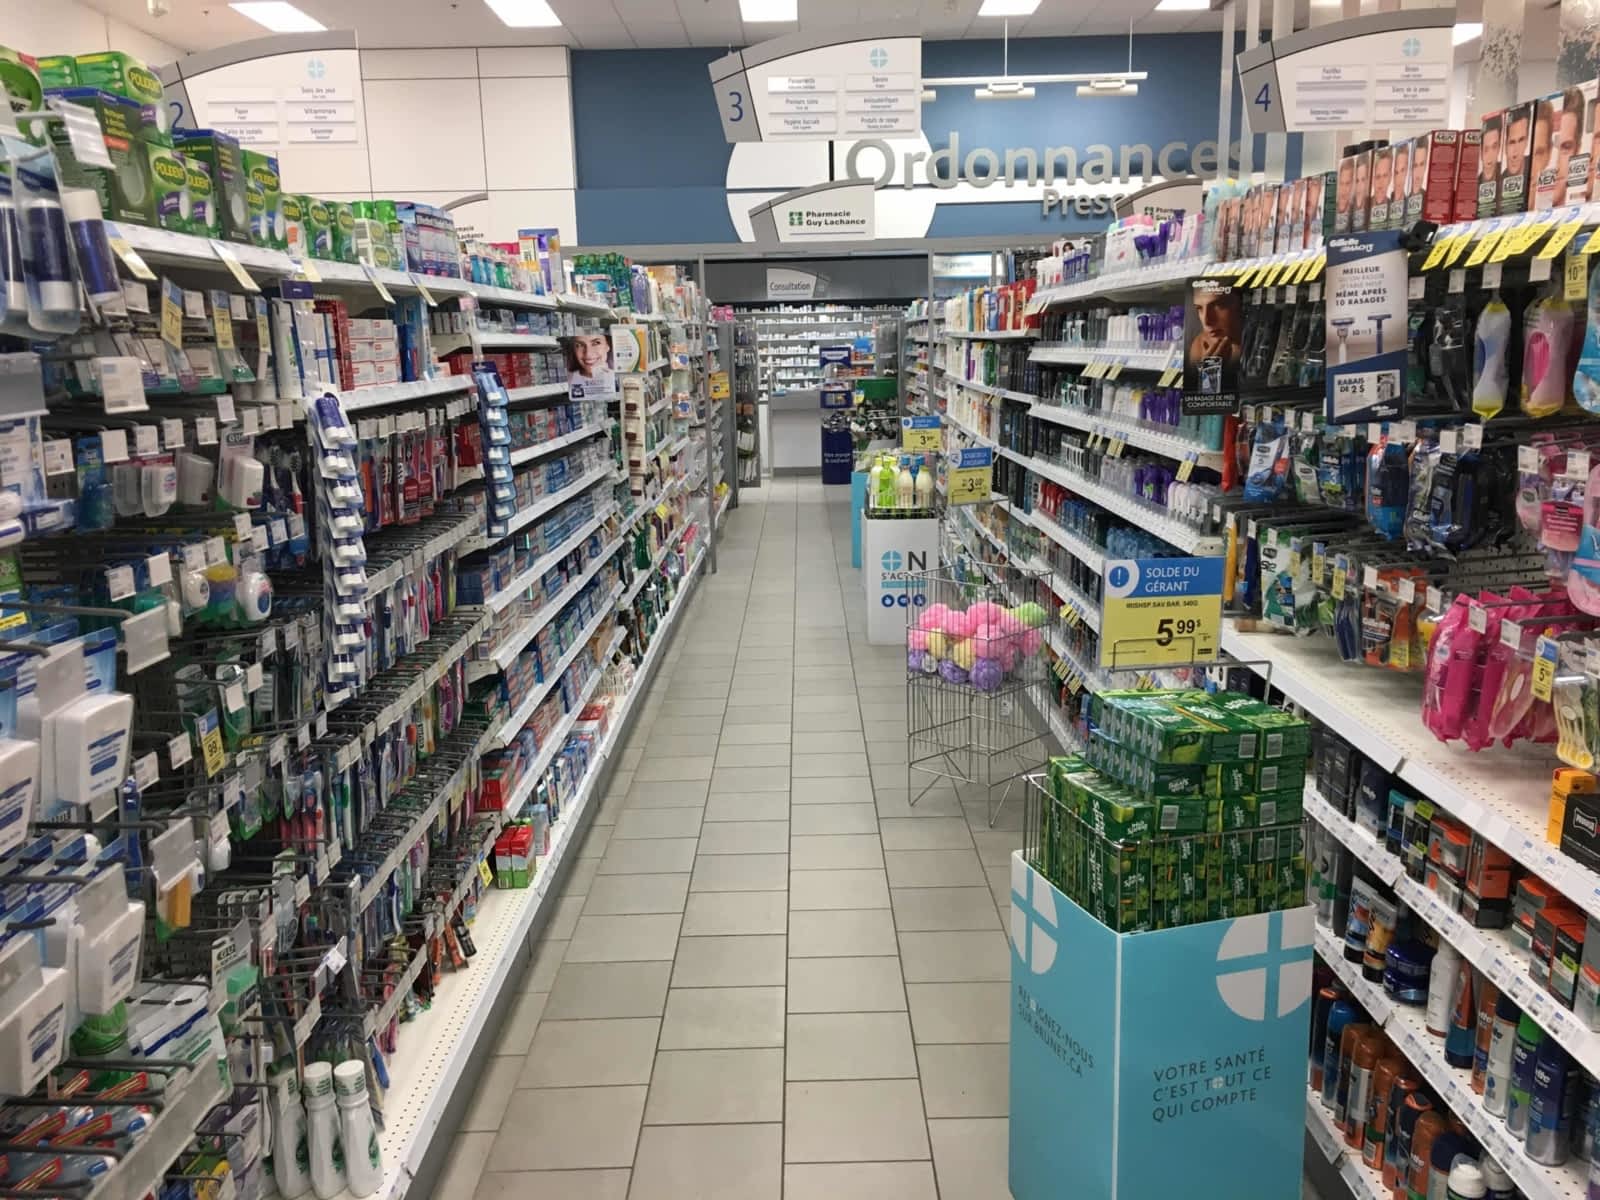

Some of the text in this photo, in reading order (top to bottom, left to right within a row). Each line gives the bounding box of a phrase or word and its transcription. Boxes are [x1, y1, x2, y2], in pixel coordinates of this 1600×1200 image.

[1254, 82, 1272, 113] 4
[728, 91, 744, 122] 3
[169, 101, 184, 129] 2
[846, 131, 1250, 190] Ordonnances
[188, 176, 210, 190] OLIDENT
[1538, 174, 1556, 186] MEN
[1504, 181, 1522, 193] MEN
[805, 209, 851, 218] Pharmacie
[805, 217, 867, 227] Guy Lachance
[1329, 237, 1360, 248] Gillette
[1343, 266, 1381, 275] MEILLEUR
[769, 280, 811, 291] Consultation
[1336, 286, 1387, 298] MÊME APRÈS
[1348, 296, 1386, 305] RASAGES
[1337, 377, 1365, 386] RABAIS
[1351, 385, 1357, 393] 2
[920, 434, 926, 444] 3
[967, 477, 974, 492] 3
[1145, 566, 1200, 579] SOLDE DU
[1145, 580, 1190, 593] GÉRANT
[1156, 618, 1174, 647] 5
[1032, 1021, 1084, 1078] BRUNET.CA
[1153, 1047, 1266, 1083] VOTRE SANTÉ
[1152, 1081, 1198, 1102] C'EST
[1251, 1064, 1272, 1082] CE
[1152, 1087, 1257, 1123] QUI COMPTE
